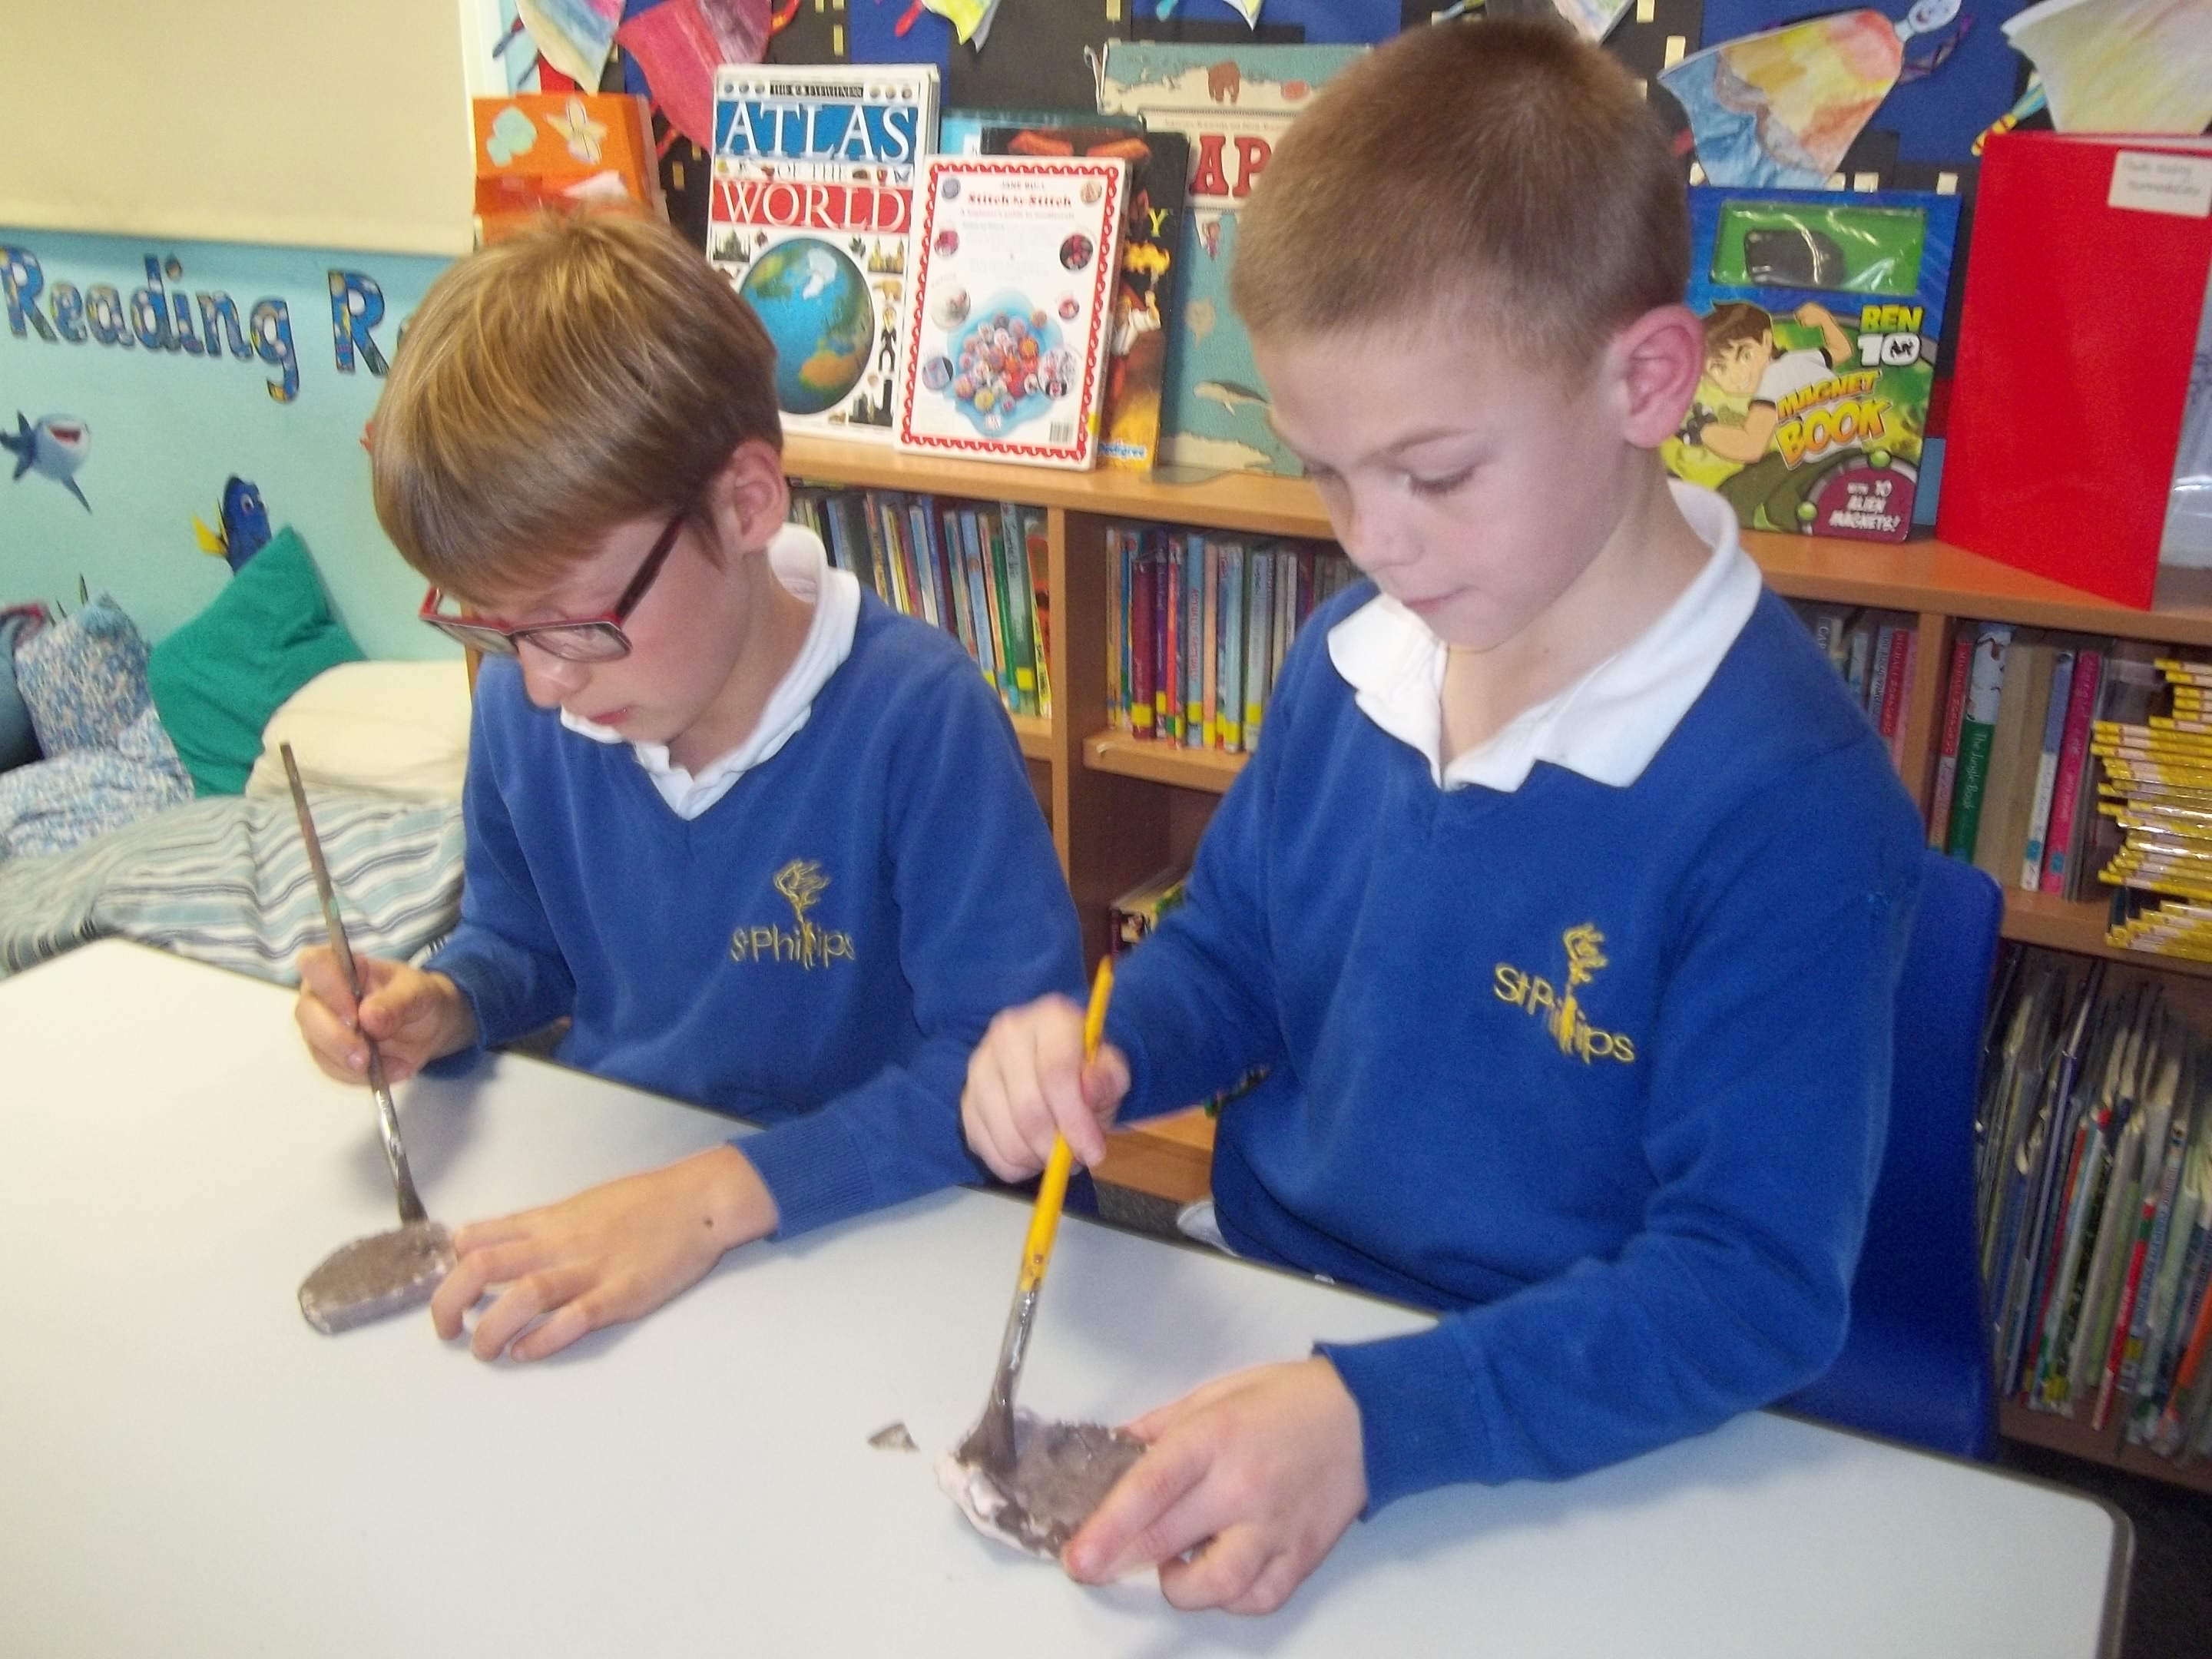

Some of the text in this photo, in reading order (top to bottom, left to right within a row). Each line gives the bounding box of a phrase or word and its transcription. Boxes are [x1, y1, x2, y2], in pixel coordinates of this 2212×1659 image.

[718, 100, 910, 164] ATLAS
[720, 179, 906, 233] WORLD
[0, 244, 415, 404] Reading R
[1860, 304, 1923, 333] BEN
[1857, 332, 1921, 366] 10
[1776, 369, 1882, 421] MAGNET
[1775, 399, 1892, 471] BOOK
[1962, 731, 1988, 810] The Jungle Book
